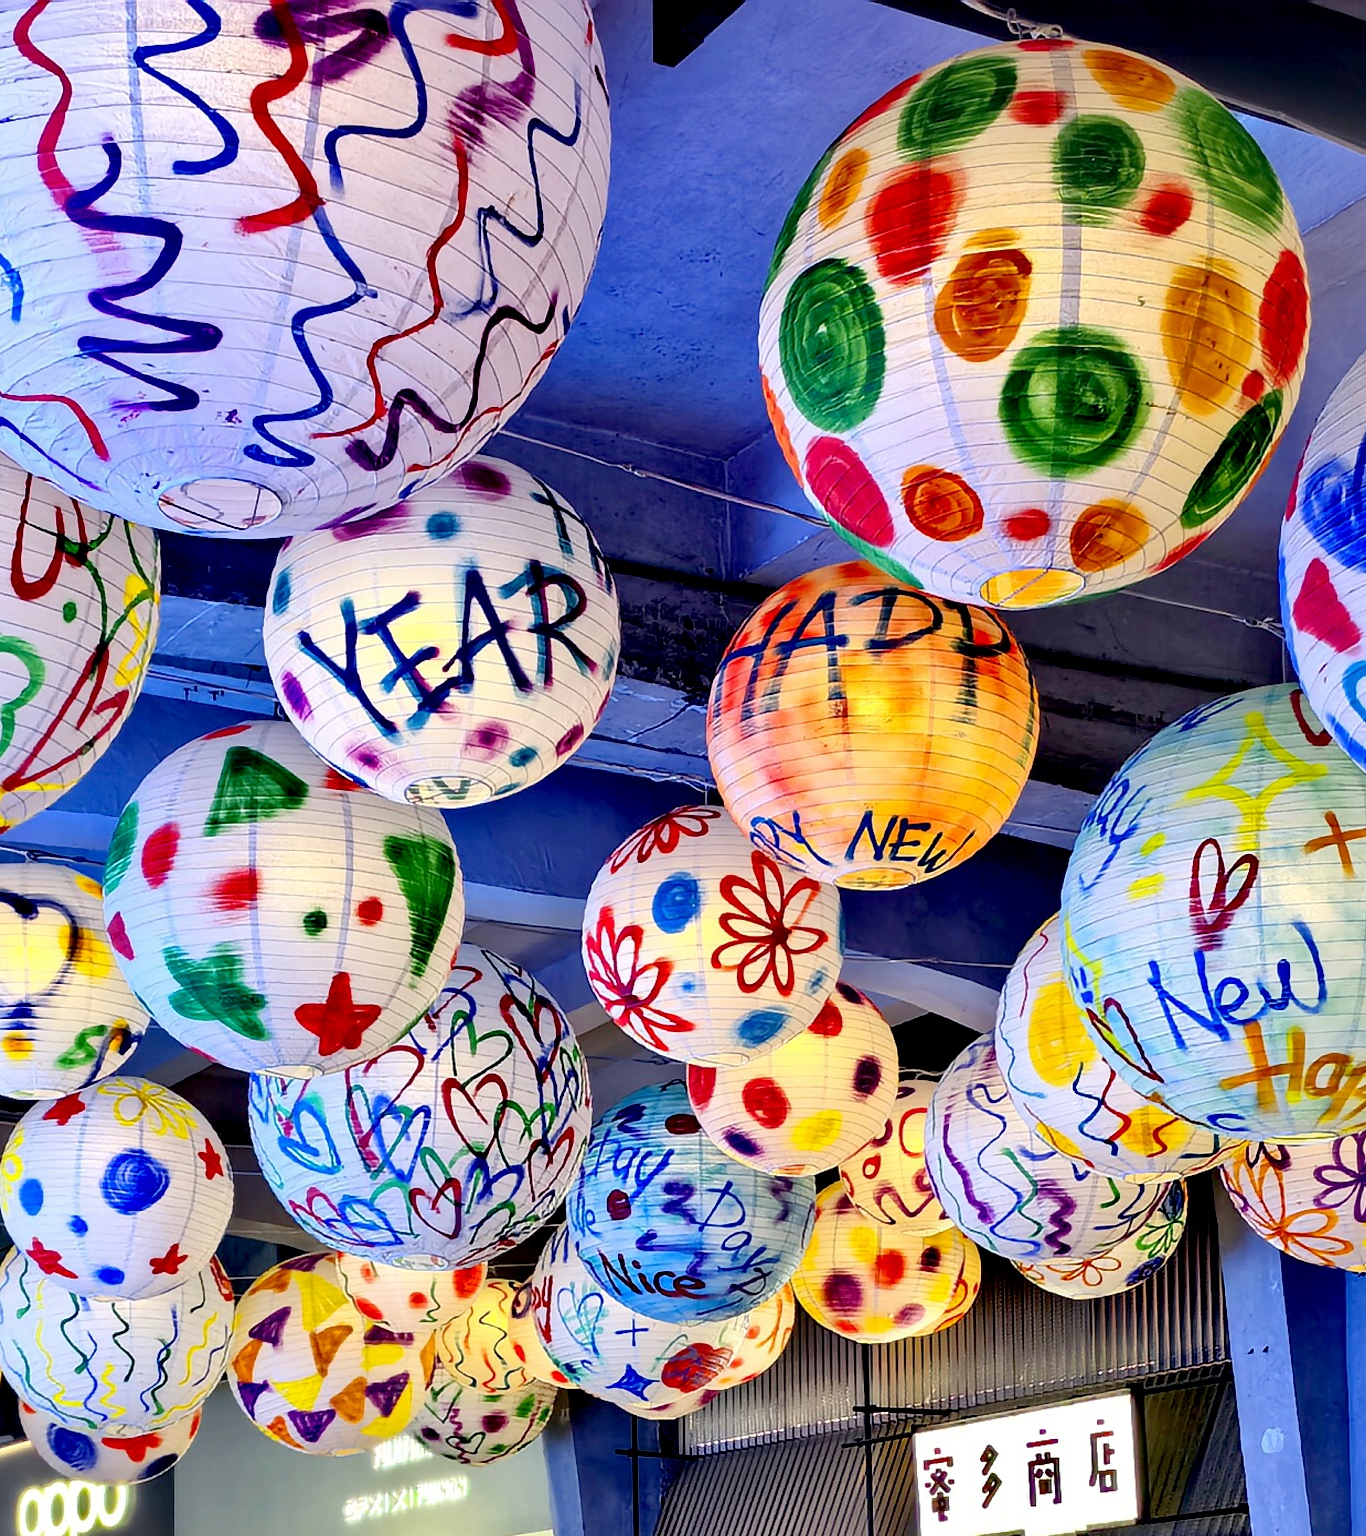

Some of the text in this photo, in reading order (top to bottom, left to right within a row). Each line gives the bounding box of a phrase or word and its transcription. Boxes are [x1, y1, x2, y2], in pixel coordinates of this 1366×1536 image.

[296, 558, 599, 745] YEAR
[844, 810, 977, 873] NEW
[1148, 918, 1329, 1051] New
[596, 1247, 709, 1300] Nice
